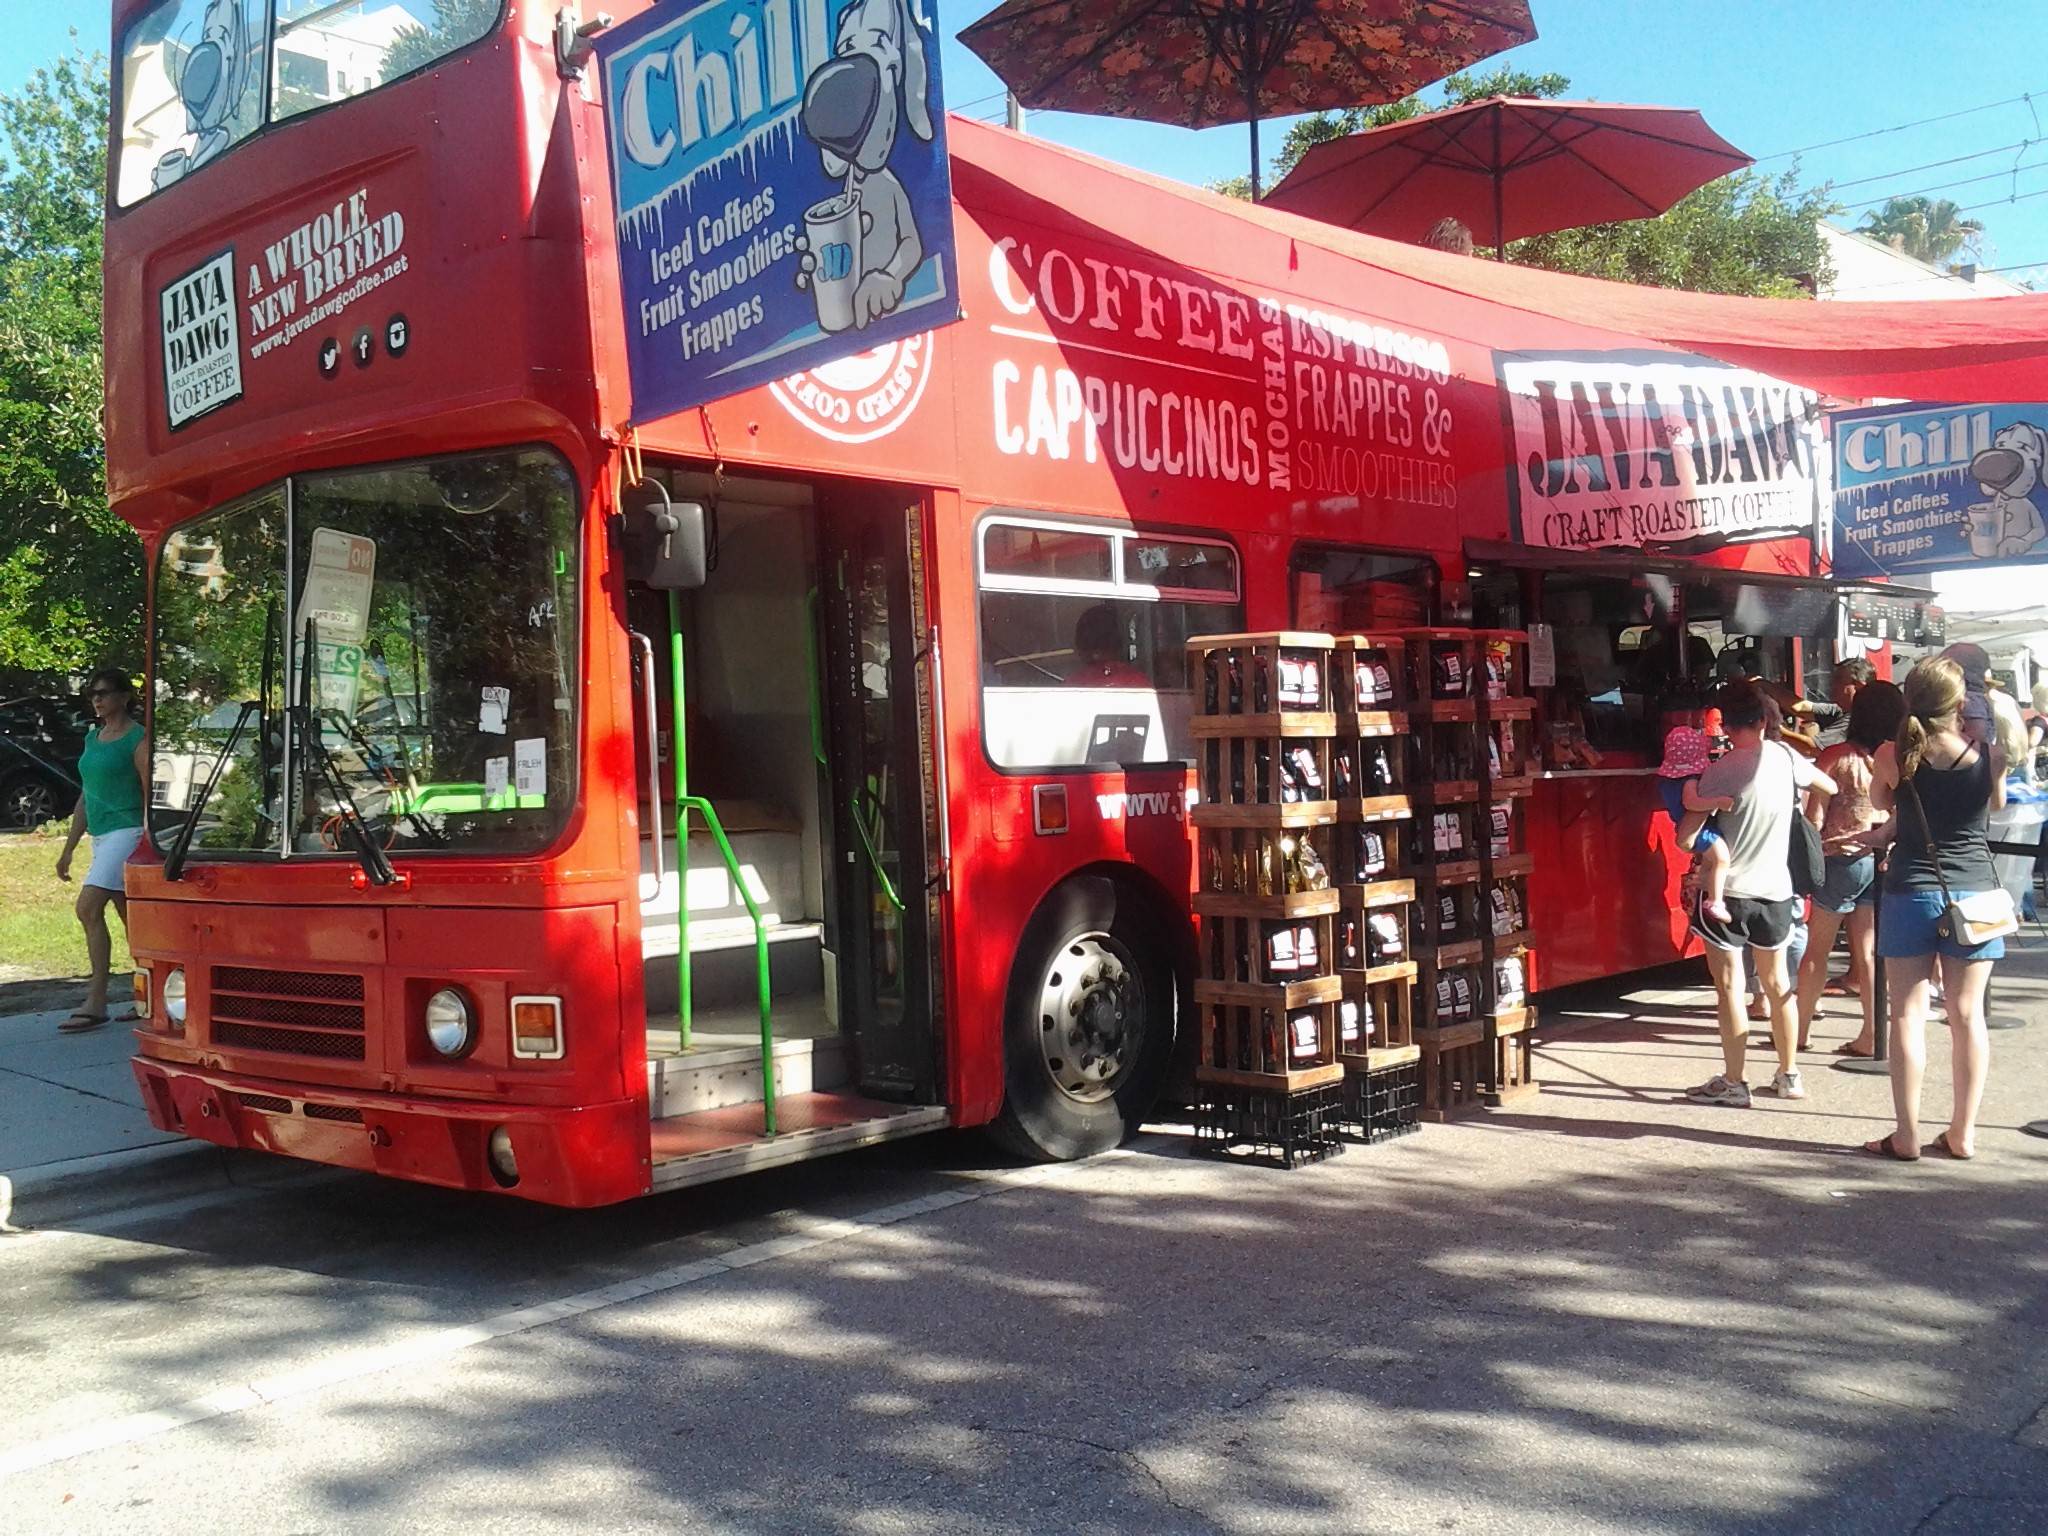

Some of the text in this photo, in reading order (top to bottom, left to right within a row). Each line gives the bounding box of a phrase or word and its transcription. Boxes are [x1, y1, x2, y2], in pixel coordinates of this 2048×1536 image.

[624, 0, 830, 169] Chill
[247, 188, 369, 299] A WHOLE
[650, 186, 775, 284] Iced Coffees
[818, 242, 854, 282] JD
[167, 266, 227, 334] JAVA
[249, 211, 404, 336] NEW BREED
[251, 254, 409, 359] www.javadawgcoffee.net
[640, 223, 796, 337] Fruit Smoothies
[990, 236, 1255, 361] COFFEE
[169, 312, 230, 375] DAWG
[681, 295, 764, 361] Frappes
[1287, 304, 1451, 386] ESPRESSO
[171, 353, 232, 392] CRAFT ROASTED
[173, 366, 236, 414] COFFEE
[1258, 297, 1291, 491] MOCHAS
[1293, 360, 1454, 458] FRAPPES &
[992, 359, 1261, 486] CAPPUCCINOS
[1527, 380, 1681, 498] JAVA
[1845, 410, 1992, 473] Chill
[1298, 439, 1457, 509] SMOOTHIES
[1856, 490, 1950, 522] Iced Coffees
[1543, 505, 1624, 548] CRAFT
[1629, 496, 1727, 539] ROASTED
[1844, 522, 1878, 544] Fruit
[1882, 509, 1962, 537] Smoothies
[1873, 534, 1934, 557] Frappes
